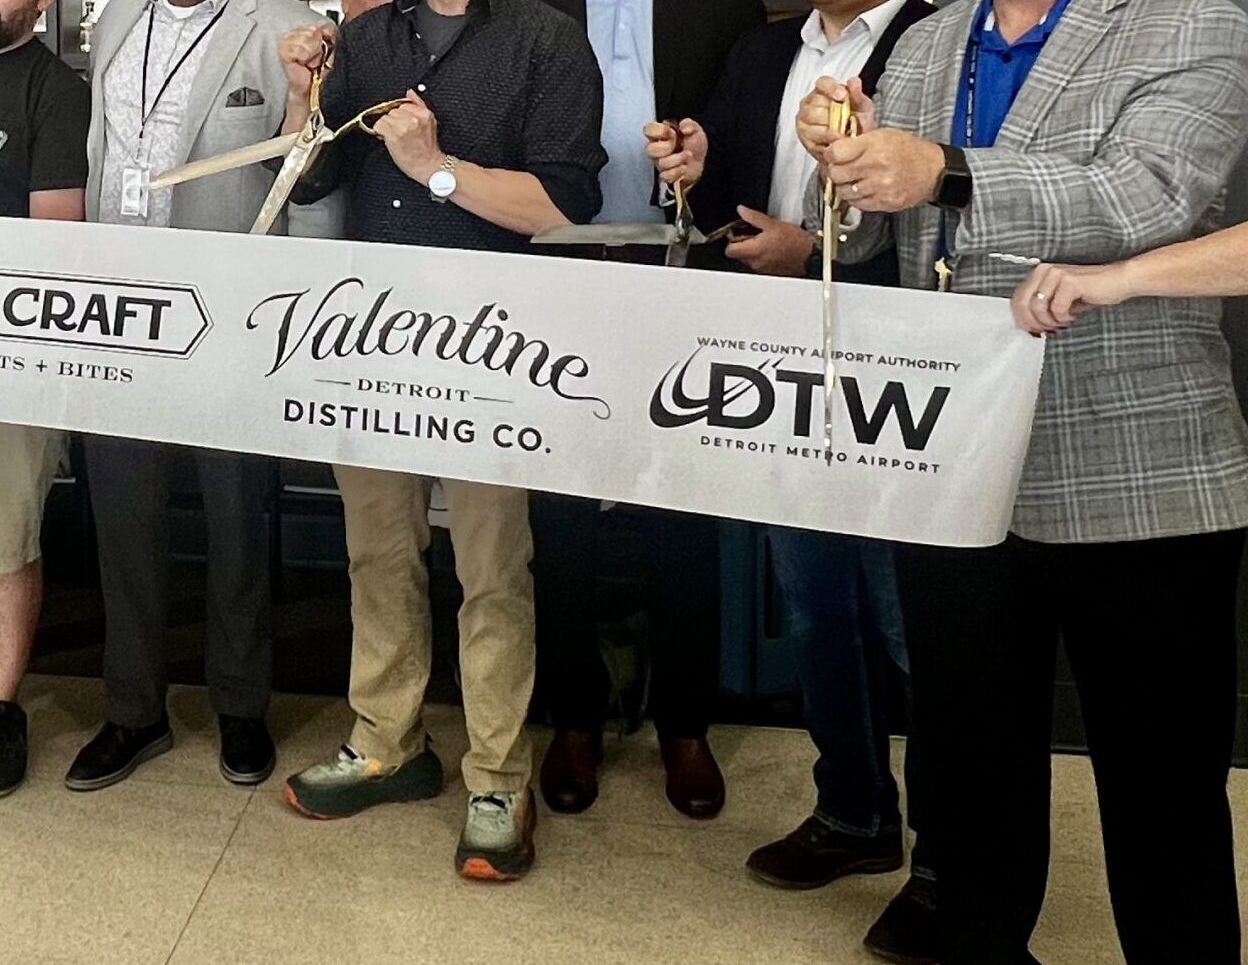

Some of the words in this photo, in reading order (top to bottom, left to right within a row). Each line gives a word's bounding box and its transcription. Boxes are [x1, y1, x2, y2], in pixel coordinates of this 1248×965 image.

[2, 286, 171, 340] CRAFT
[246, 277, 611, 420] Valentine
[697, 336, 746, 351] WAYNE
[749, 341, 807, 357] COUNTY
[877, 355, 961, 373] AUTHORITY
[57, 361, 134, 383] BITES
[357, 378, 470, 403] DETROIT
[283, 398, 475, 444] DISTILLING
[492, 423, 551, 454] CO.
[706, 362, 951, 451] DTW
[700, 435, 777, 453] DETROIT
[857, 454, 941, 473] AIRPORT
